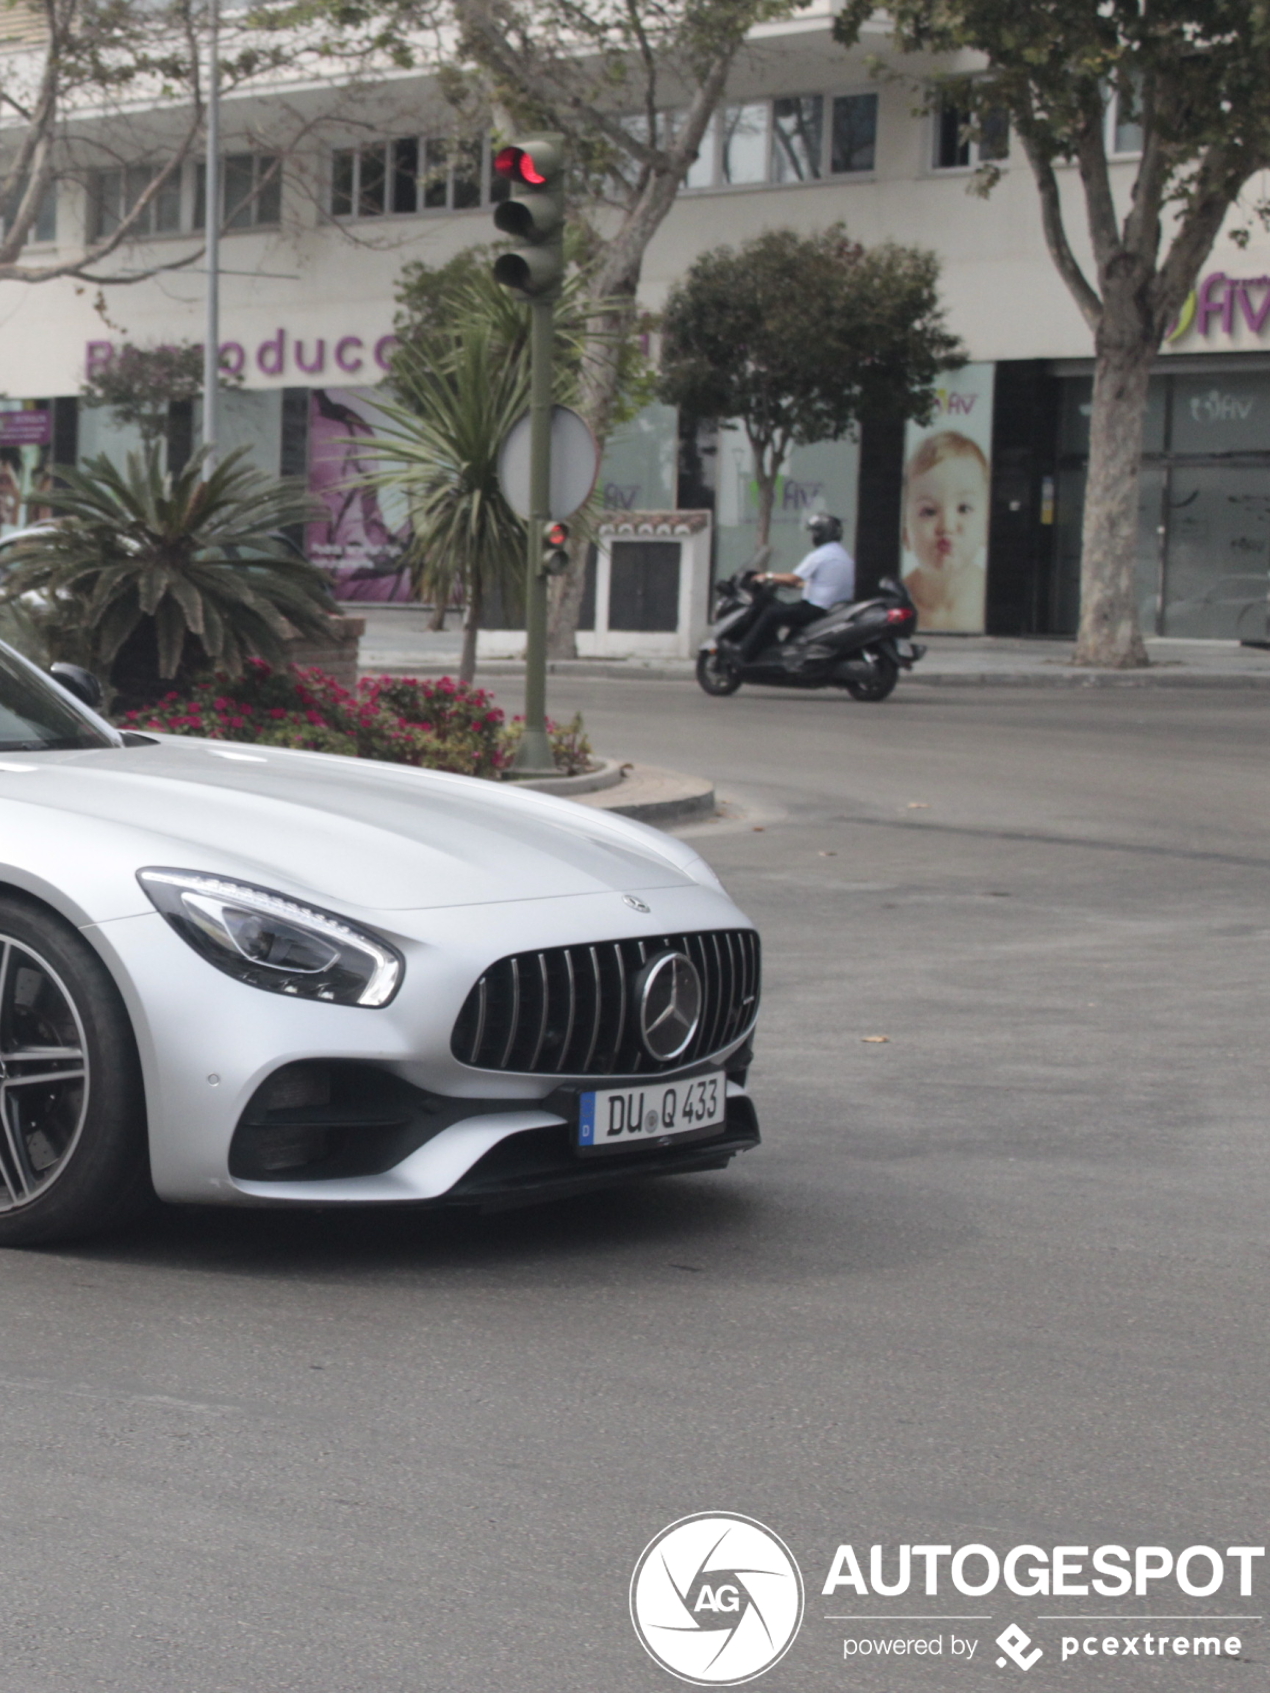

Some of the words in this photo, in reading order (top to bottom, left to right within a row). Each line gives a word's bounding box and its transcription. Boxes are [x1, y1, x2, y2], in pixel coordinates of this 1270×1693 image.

[606, 1092, 644, 1136] DU
[661, 1088, 677, 1128] Q
[682, 1078, 718, 1123] 433
